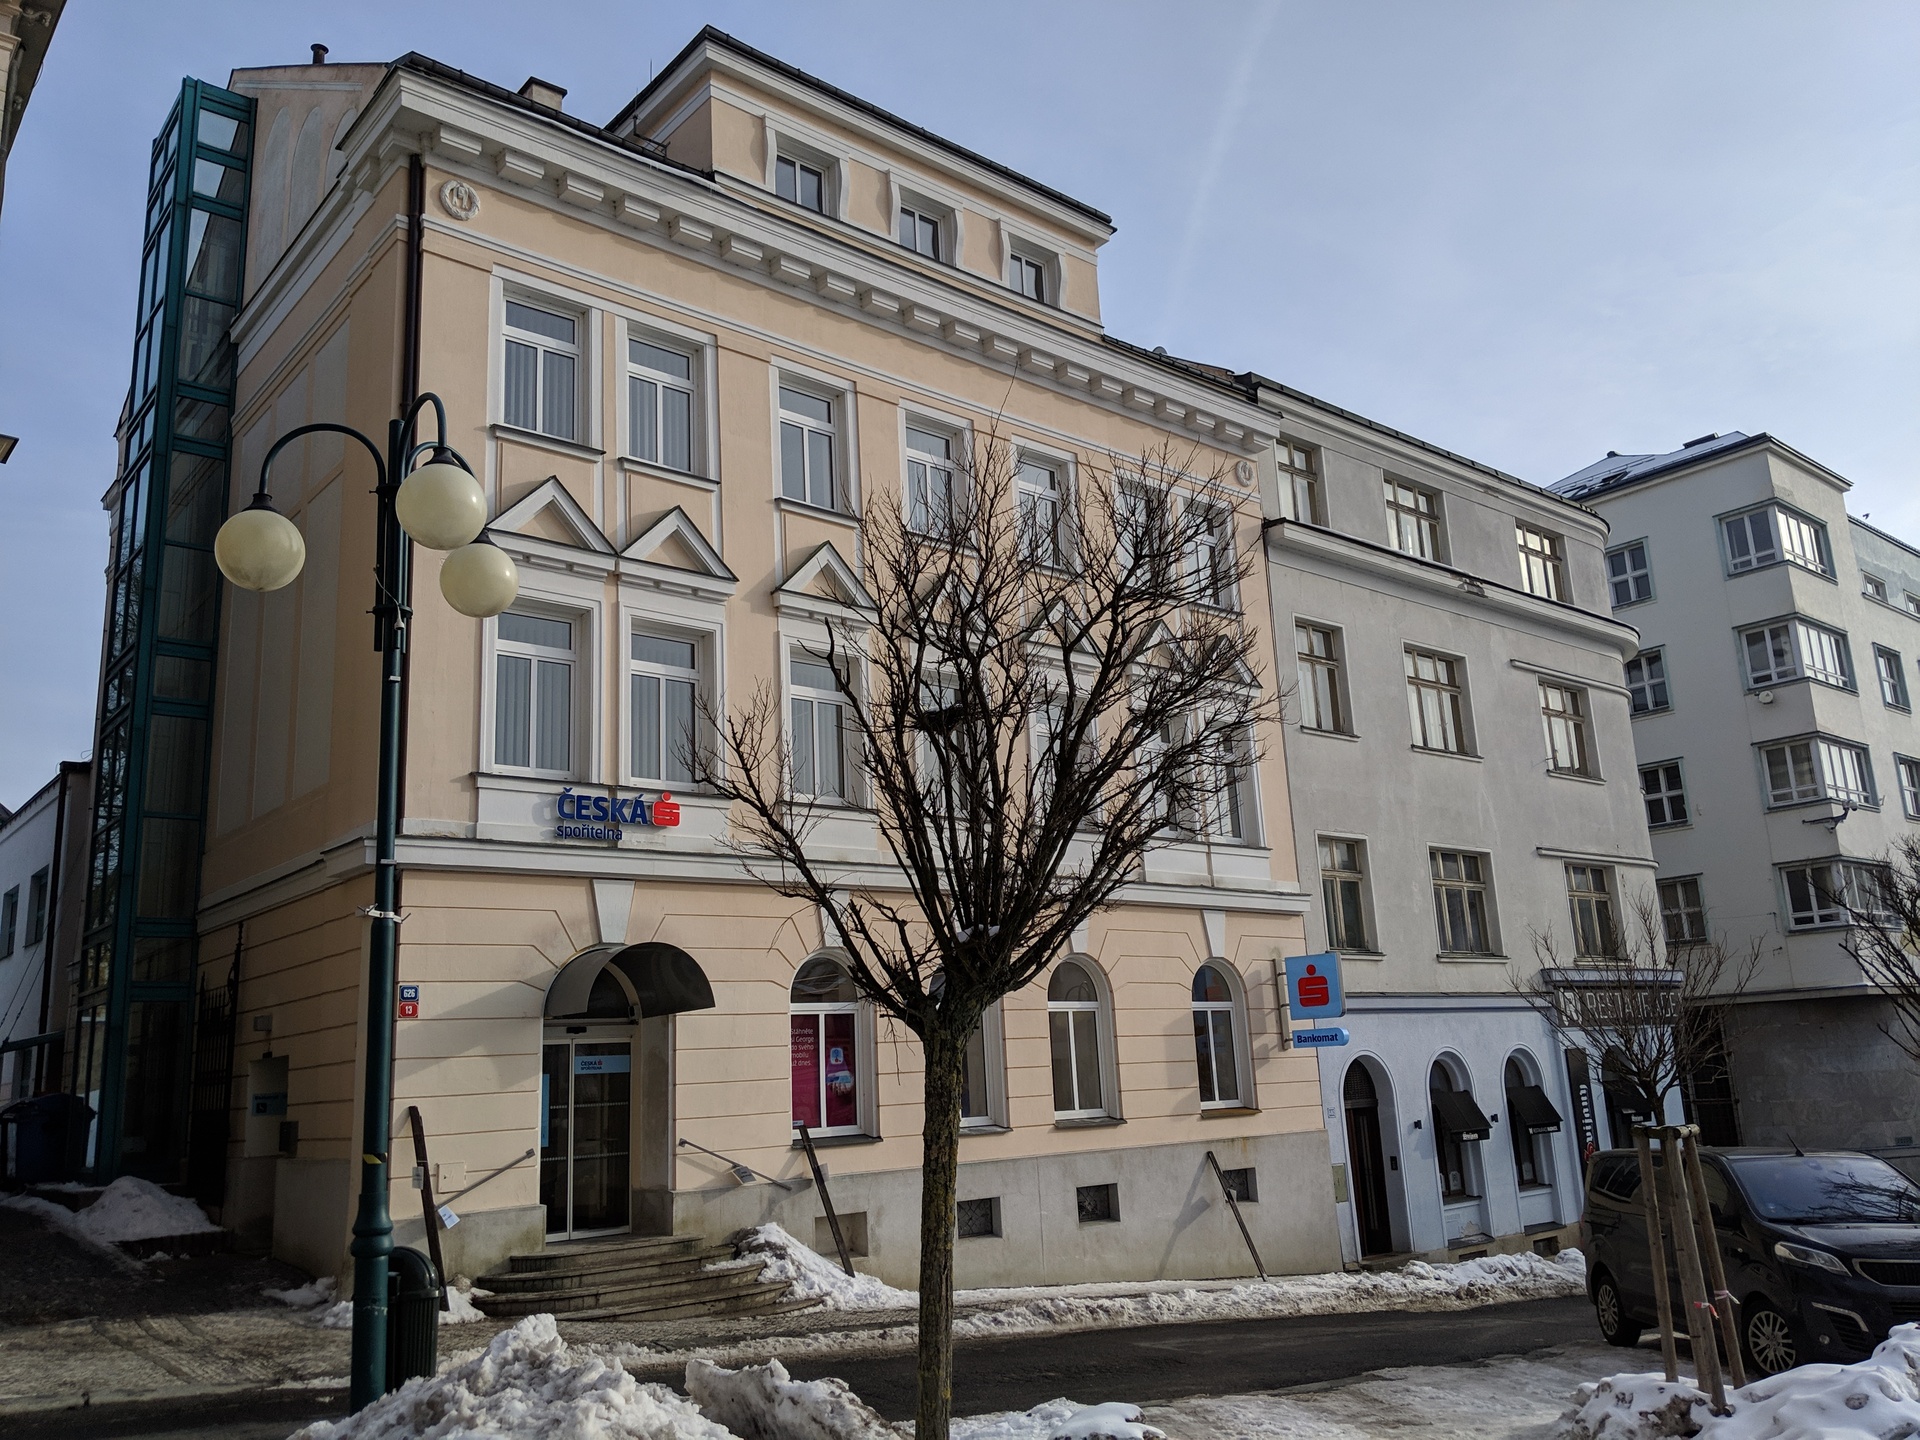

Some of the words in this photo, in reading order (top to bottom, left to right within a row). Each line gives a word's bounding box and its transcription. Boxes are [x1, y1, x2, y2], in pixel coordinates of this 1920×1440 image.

[557, 787, 648, 825] ČESKÁ
[556, 824, 622, 840] spořitelna
[405, 1005, 413, 1015] 13
[796, 1036, 815, 1044] George
[1296, 1033, 1339, 1044] Bankomat
